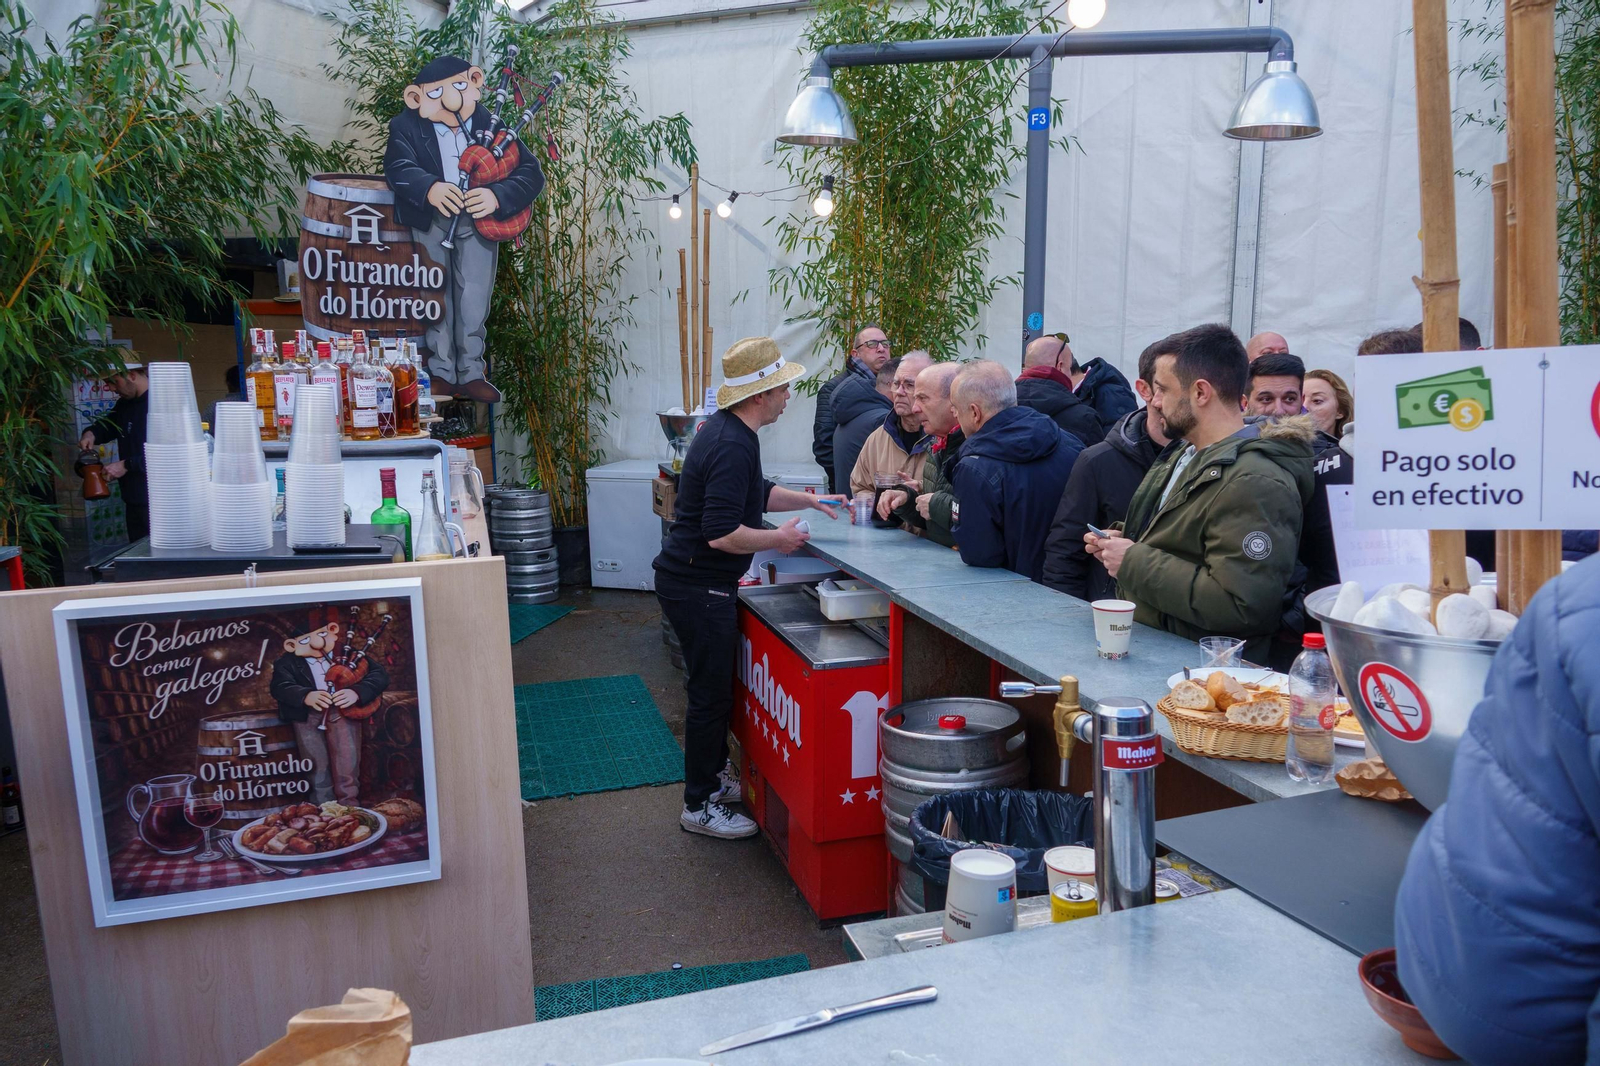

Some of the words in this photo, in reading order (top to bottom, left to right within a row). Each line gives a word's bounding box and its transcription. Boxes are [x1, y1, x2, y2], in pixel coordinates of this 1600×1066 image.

[1031, 113, 1047, 126] F3
[303, 247, 322, 280] O
[325, 249, 444, 289] Furancho
[319, 286, 346, 316] do
[350, 287, 441, 321] Hórreo
[1382, 450, 1450, 477] Pago
[1457, 447, 1516, 471] solo
[1372, 488, 1404, 506] en
[1411, 482, 1524, 506] efectivo
[109, 618, 251, 667] Bebamos
[142, 656, 194, 677] coma
[149, 638, 269, 720] galegos!
[737, 633, 802, 749] Mahou
[1117, 745, 1156, 759] Mahou
[200, 762, 216, 782] O
[217, 753, 313, 781] Furancho
[213, 784, 235, 802] do
[236, 779, 310, 801] Hórreo
